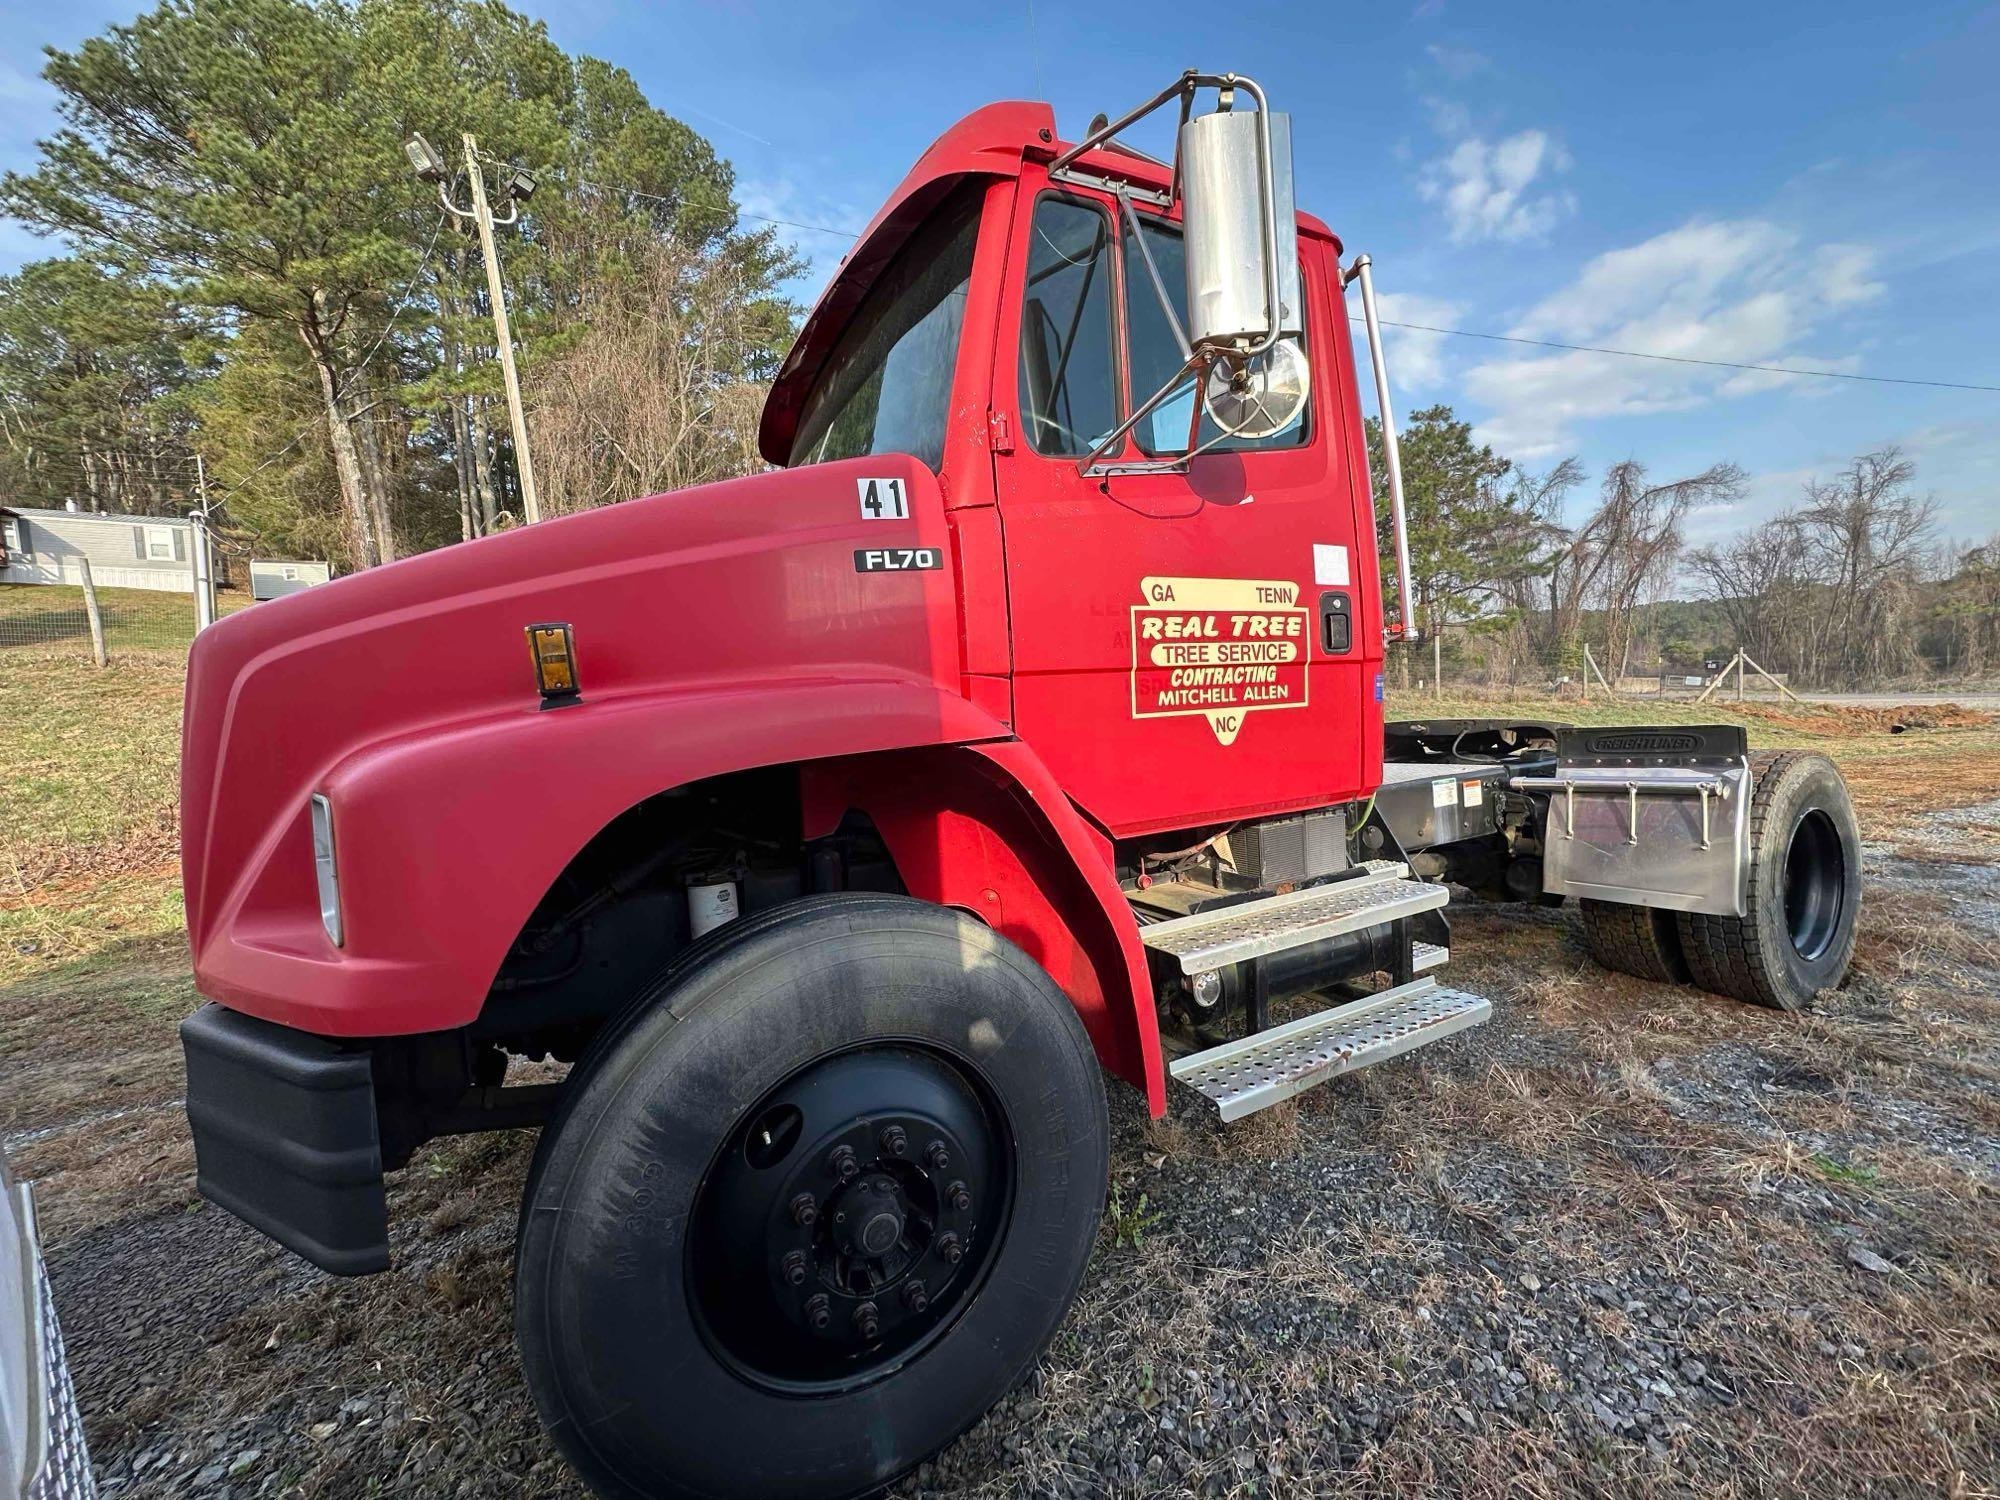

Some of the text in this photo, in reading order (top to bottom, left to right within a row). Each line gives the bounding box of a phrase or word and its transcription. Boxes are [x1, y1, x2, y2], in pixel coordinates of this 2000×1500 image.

[864, 479, 903, 518] 41
[865, 549, 934, 570] FL70
[1151, 583, 1293, 604] GA TENN
[1141, 615, 1220, 640] REAL
[1230, 614, 1303, 638] TREE
[1162, 643, 1288, 664] TREE SERVICE
[1170, 664, 1277, 688] CONTRACTING
[1158, 684, 1289, 707] MITCHELL ALLEN
[1215, 714, 1237, 733] NC
[1595, 736, 1693, 750] FREIGHTLINER
